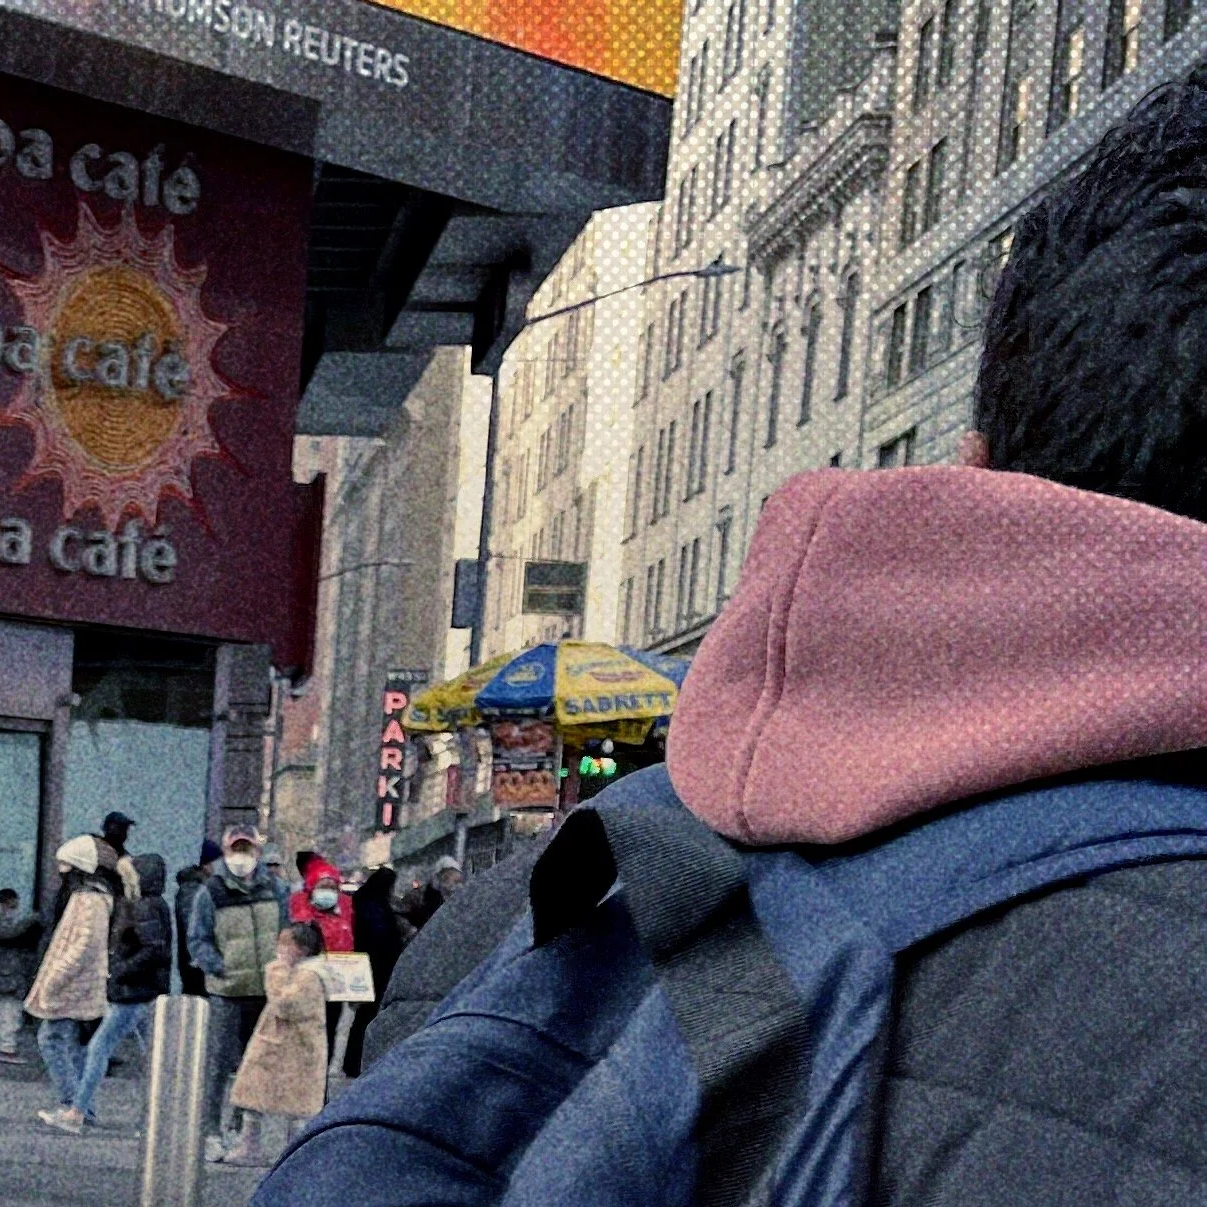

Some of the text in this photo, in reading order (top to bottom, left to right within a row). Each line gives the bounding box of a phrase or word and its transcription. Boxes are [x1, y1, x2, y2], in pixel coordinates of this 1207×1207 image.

[283, 19, 410, 87] REUTERS
[69, 143, 201, 215] café
[63, 333, 191, 398] café
[49, 518, 178, 584] café
[377, 690, 408, 828] PARKI
